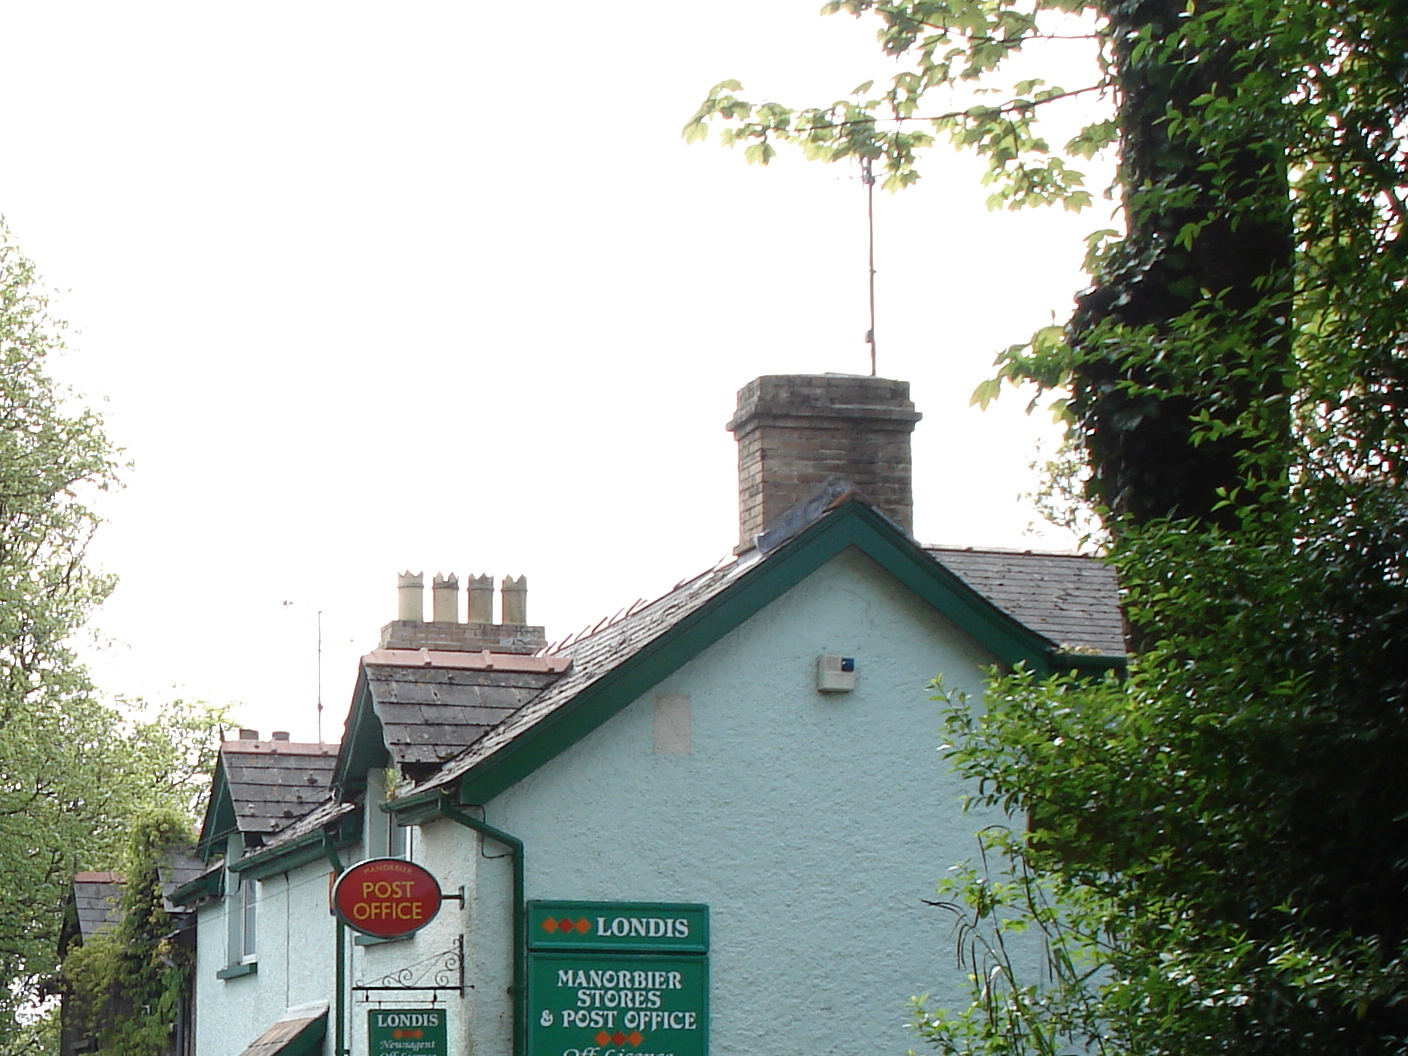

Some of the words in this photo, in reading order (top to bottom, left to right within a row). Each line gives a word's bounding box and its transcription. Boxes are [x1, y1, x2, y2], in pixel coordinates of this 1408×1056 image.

[364, 864, 412, 874] MANORBIER
[363, 882, 414, 898] POST
[353, 903, 422, 919] OFFICE
[597, 917, 689, 938] LONDIS
[558, 970, 681, 989] MANORBIER
[577, 989, 662, 1008] STORES
[377, 1014, 439, 1027] LONDIS
[540, 1009, 554, 1027] &
[562, 1010, 617, 1028] POST
[624, 1011, 697, 1032] OFFICE
[380, 1041, 435, 1051] Newsagent
